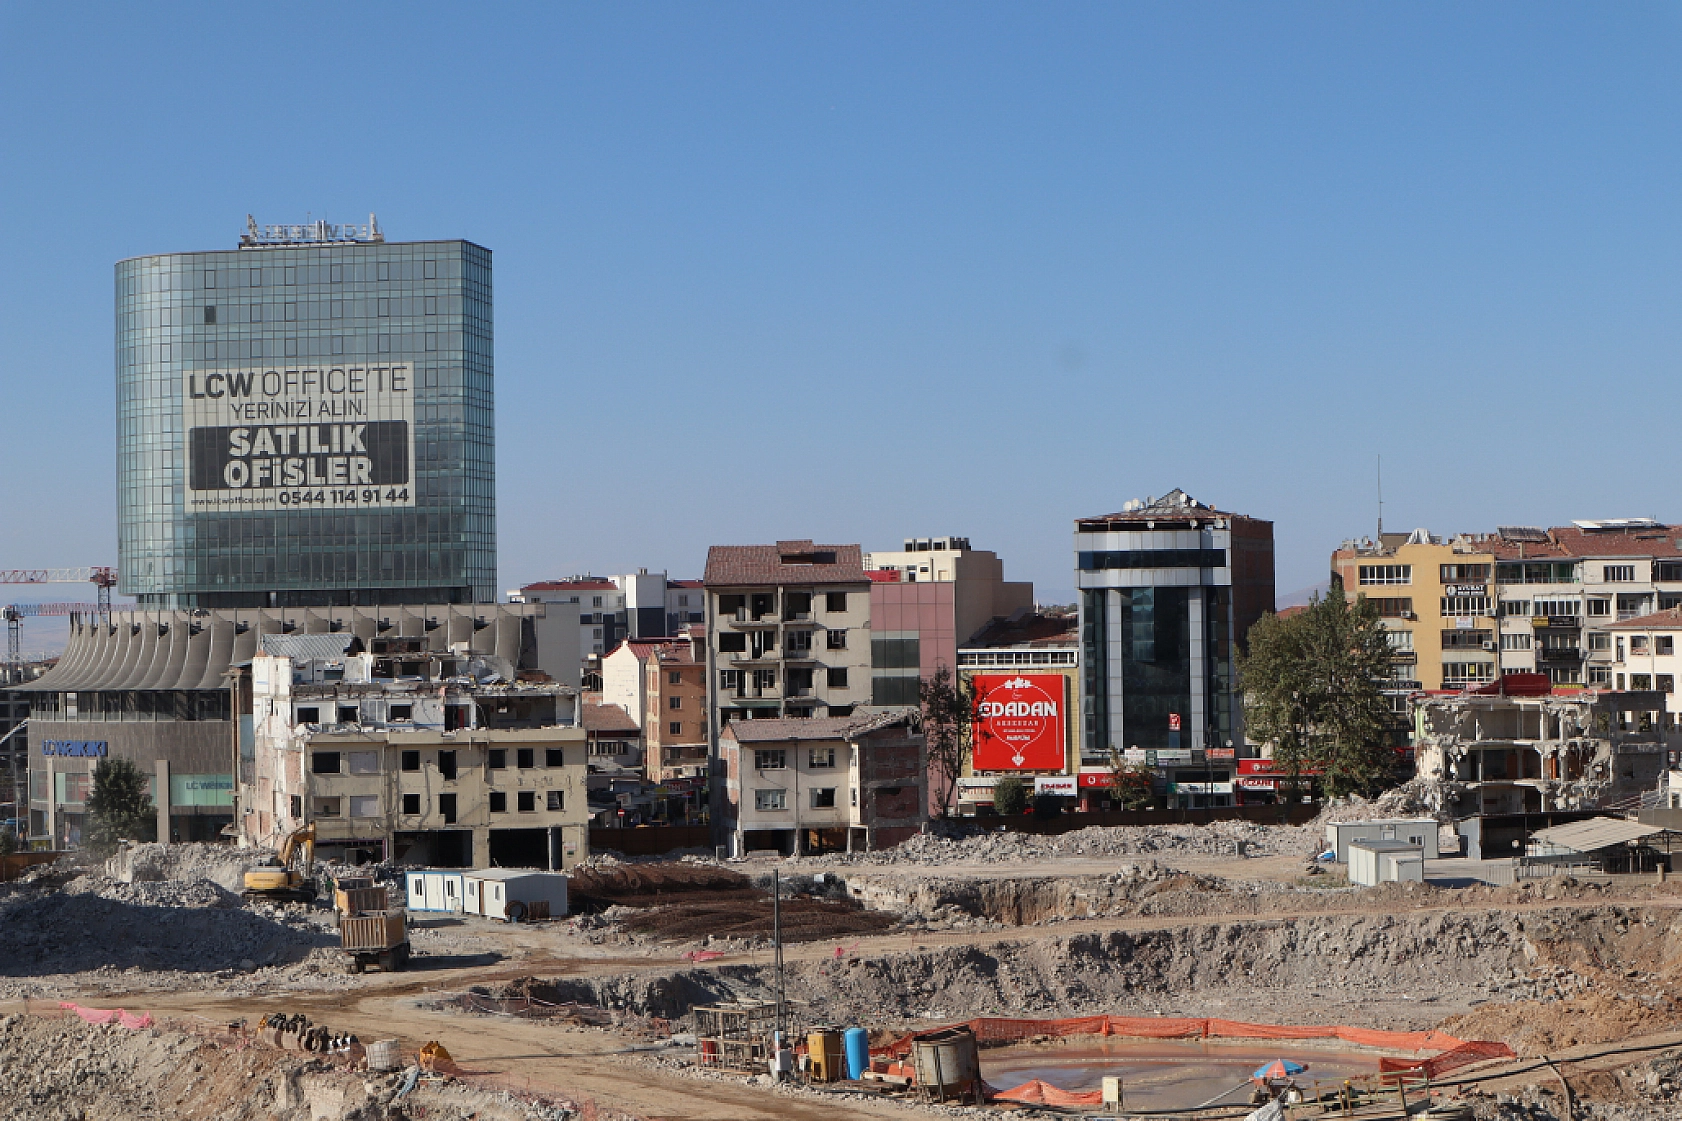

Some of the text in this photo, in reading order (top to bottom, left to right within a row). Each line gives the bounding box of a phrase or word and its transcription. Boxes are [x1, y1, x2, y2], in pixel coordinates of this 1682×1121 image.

[189, 366, 408, 399] LCW OFFICE'TE
[230, 397, 367, 420] YERİNİZİ ALIN.
[228, 424, 367, 457] SATILIK
[223, 456, 374, 488] OFİSLER
[279, 489, 326, 505] 0544
[330, 489, 357, 504] 114
[362, 488, 380, 503] 91
[385, 487, 409, 503] 44
